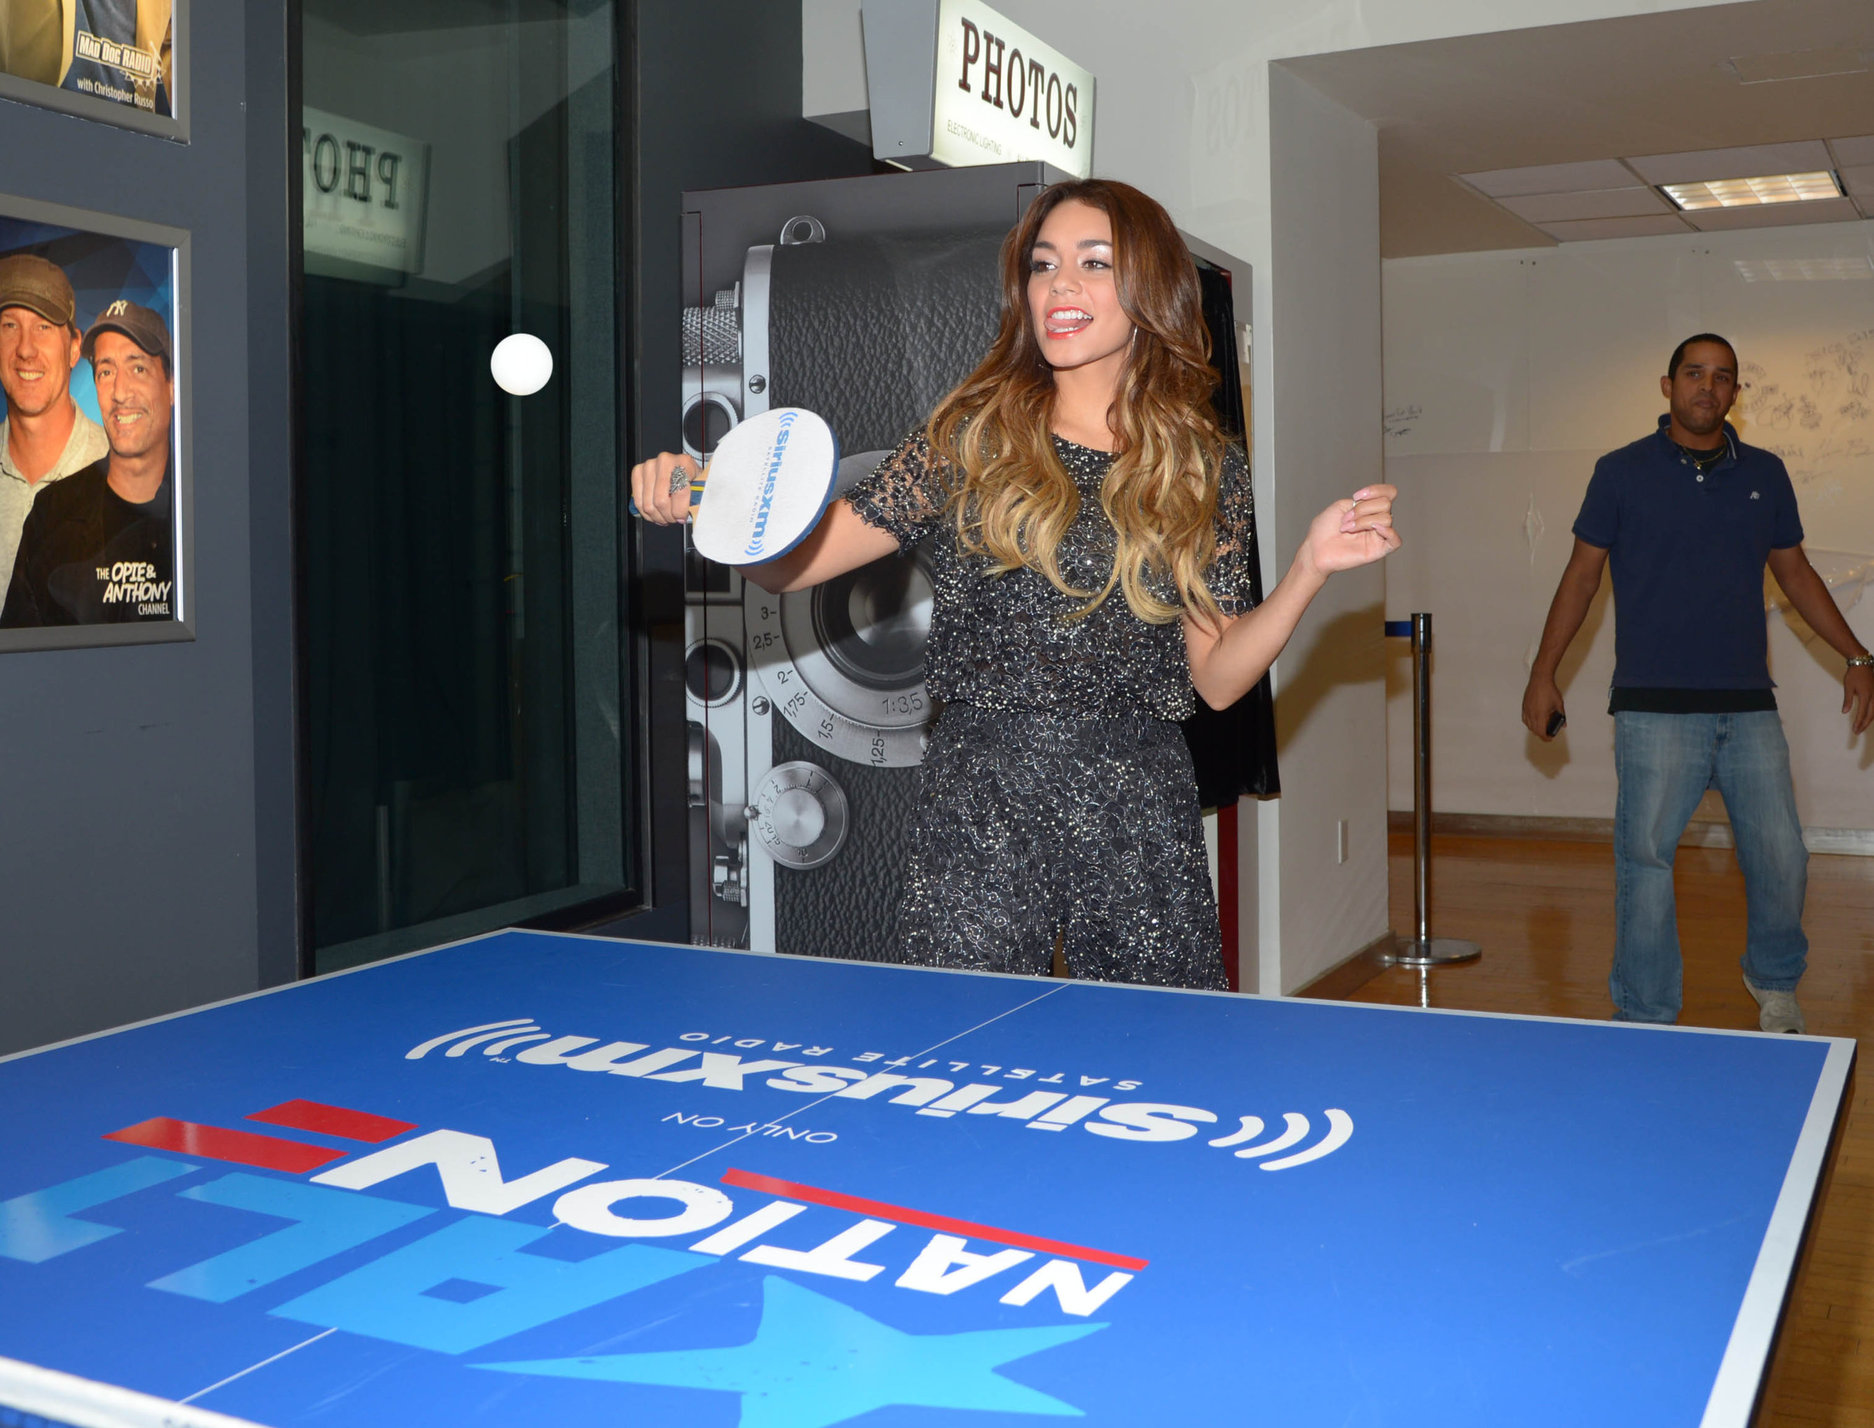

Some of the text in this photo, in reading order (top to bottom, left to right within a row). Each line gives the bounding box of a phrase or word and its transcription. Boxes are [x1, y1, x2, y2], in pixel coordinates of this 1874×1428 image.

[79, 35, 151, 74] MAD DOG RADIO
[77, 78, 154, 109] with Christopher Russo
[958, 16, 1078, 149] PHOTOS
[96, 562, 157, 583] THE OPIE &
[102, 581, 172, 603] ANTHONY
[138, 602, 170, 615] CHANNEL
[679, 1032, 1143, 1091] SATELLITE RADIO
[661, 1111, 838, 1144] ONLY ON
[309, 1129, 1135, 1317] NATION
